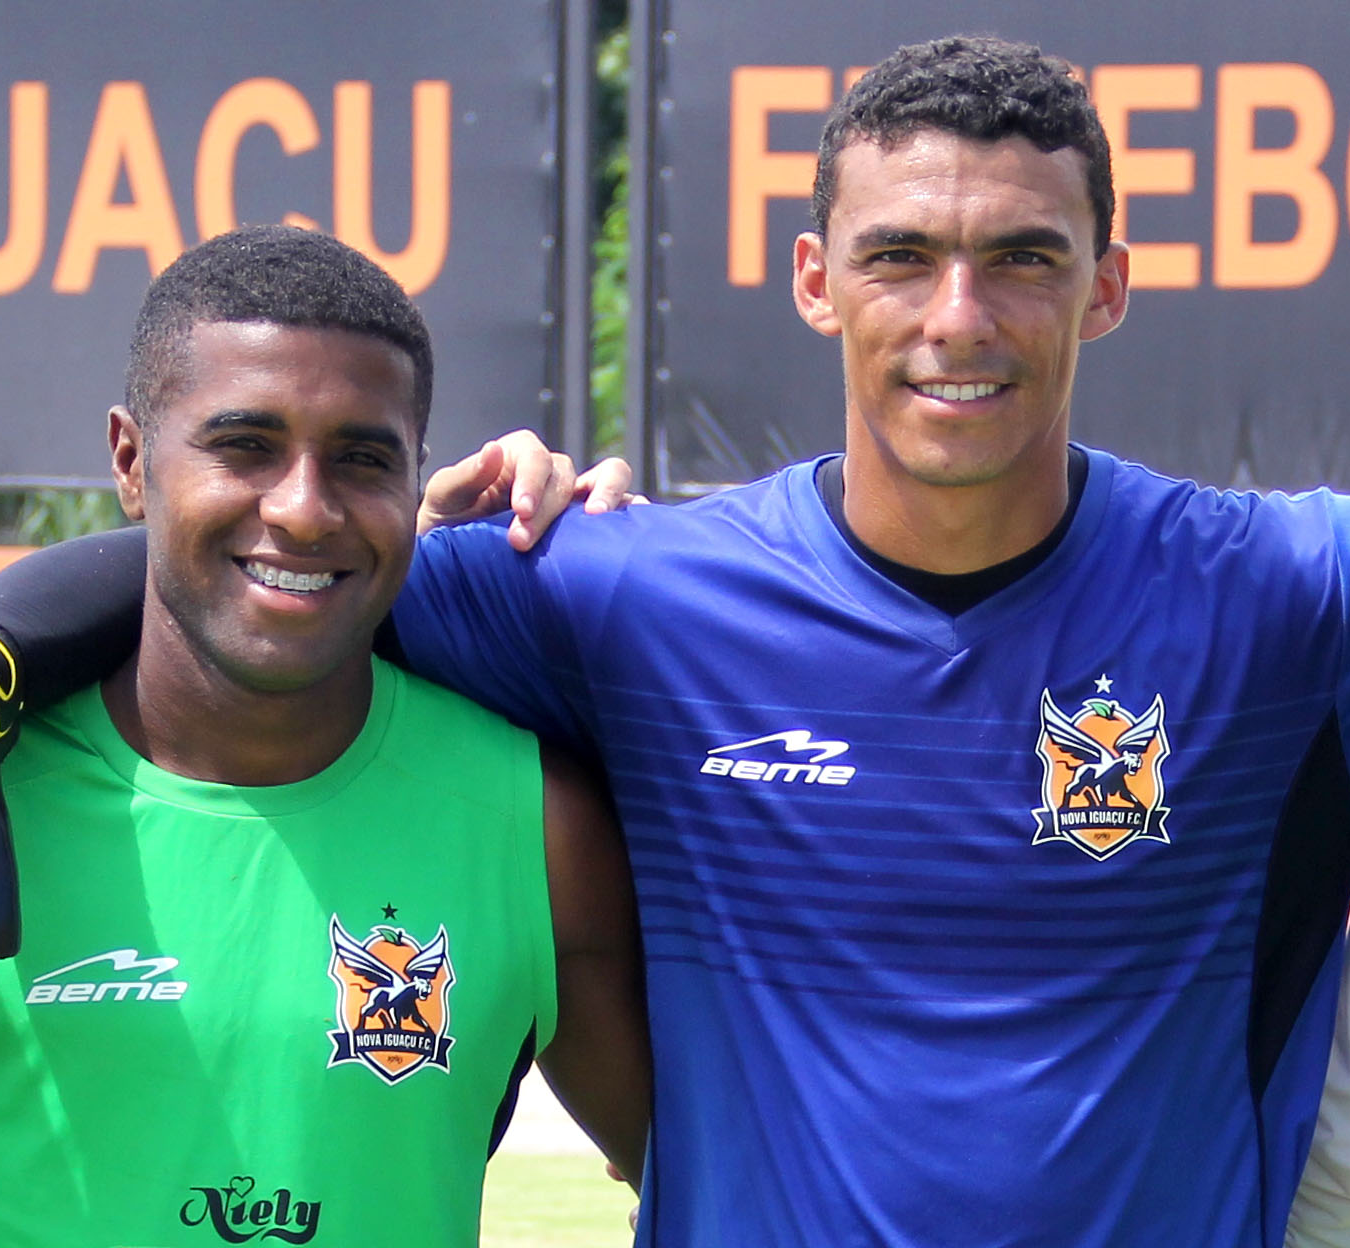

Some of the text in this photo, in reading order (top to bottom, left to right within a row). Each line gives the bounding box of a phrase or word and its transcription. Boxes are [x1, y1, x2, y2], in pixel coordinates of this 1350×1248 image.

[1060, 811, 1087, 826] NOVA
[356, 1033, 382, 1047] NOVA
[179, 1175, 323, 1244] Niely
